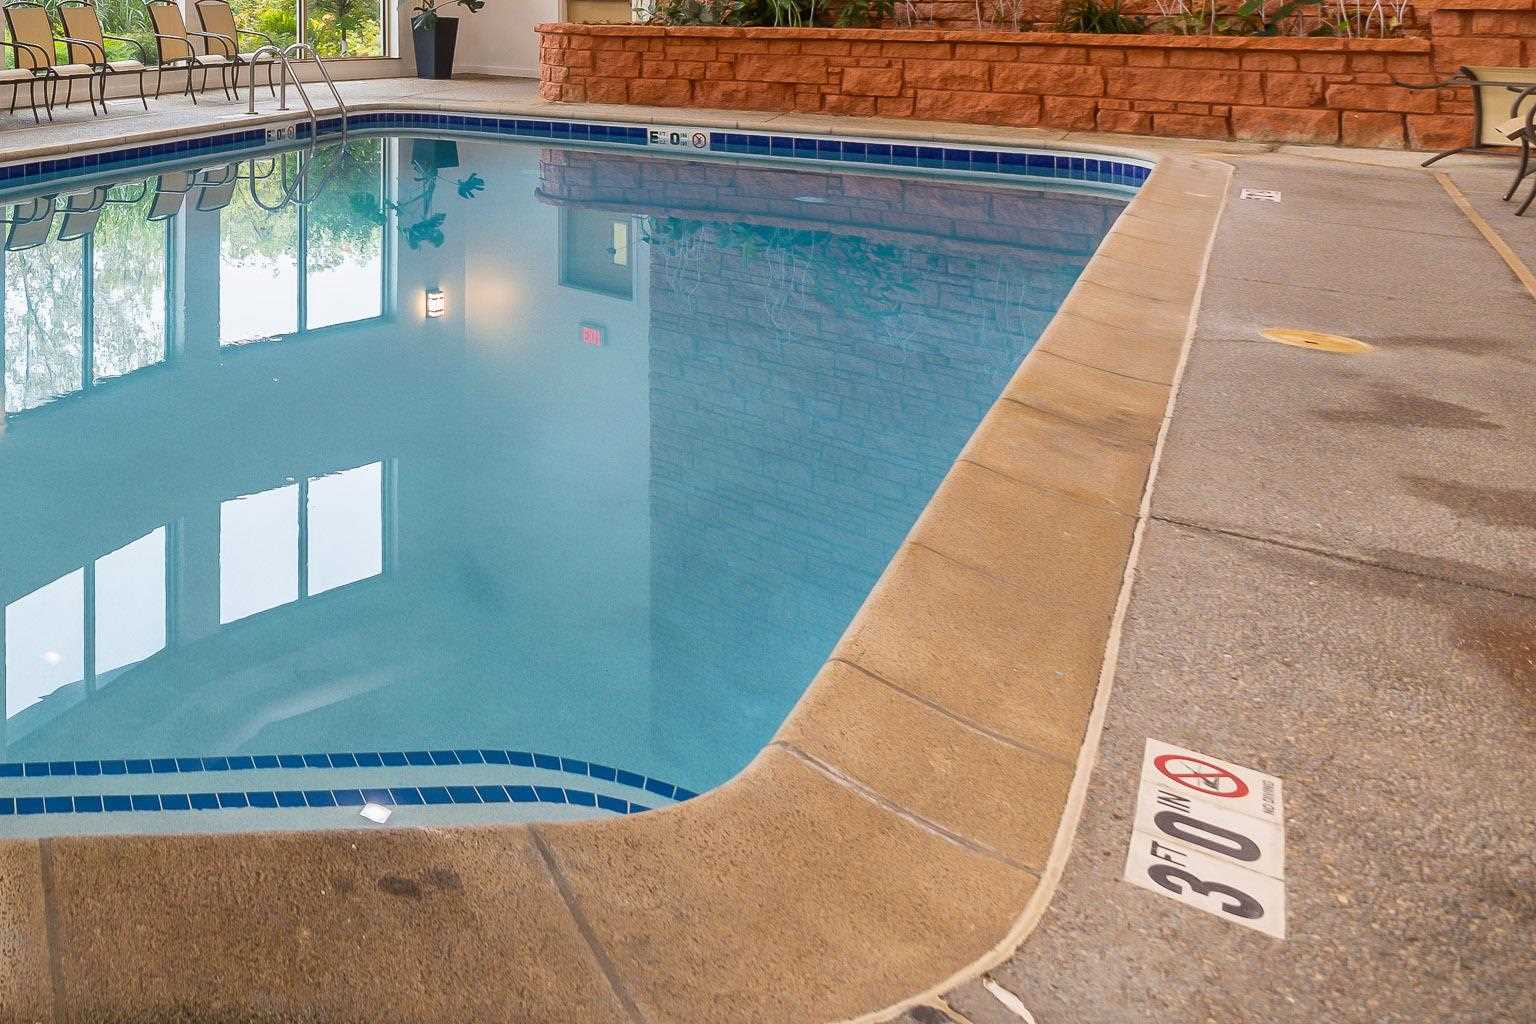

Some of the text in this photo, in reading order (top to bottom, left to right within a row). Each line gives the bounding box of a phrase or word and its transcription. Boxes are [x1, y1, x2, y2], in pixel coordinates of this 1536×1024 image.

[1147, 789, 1265, 920] 3 FT 0 IN
